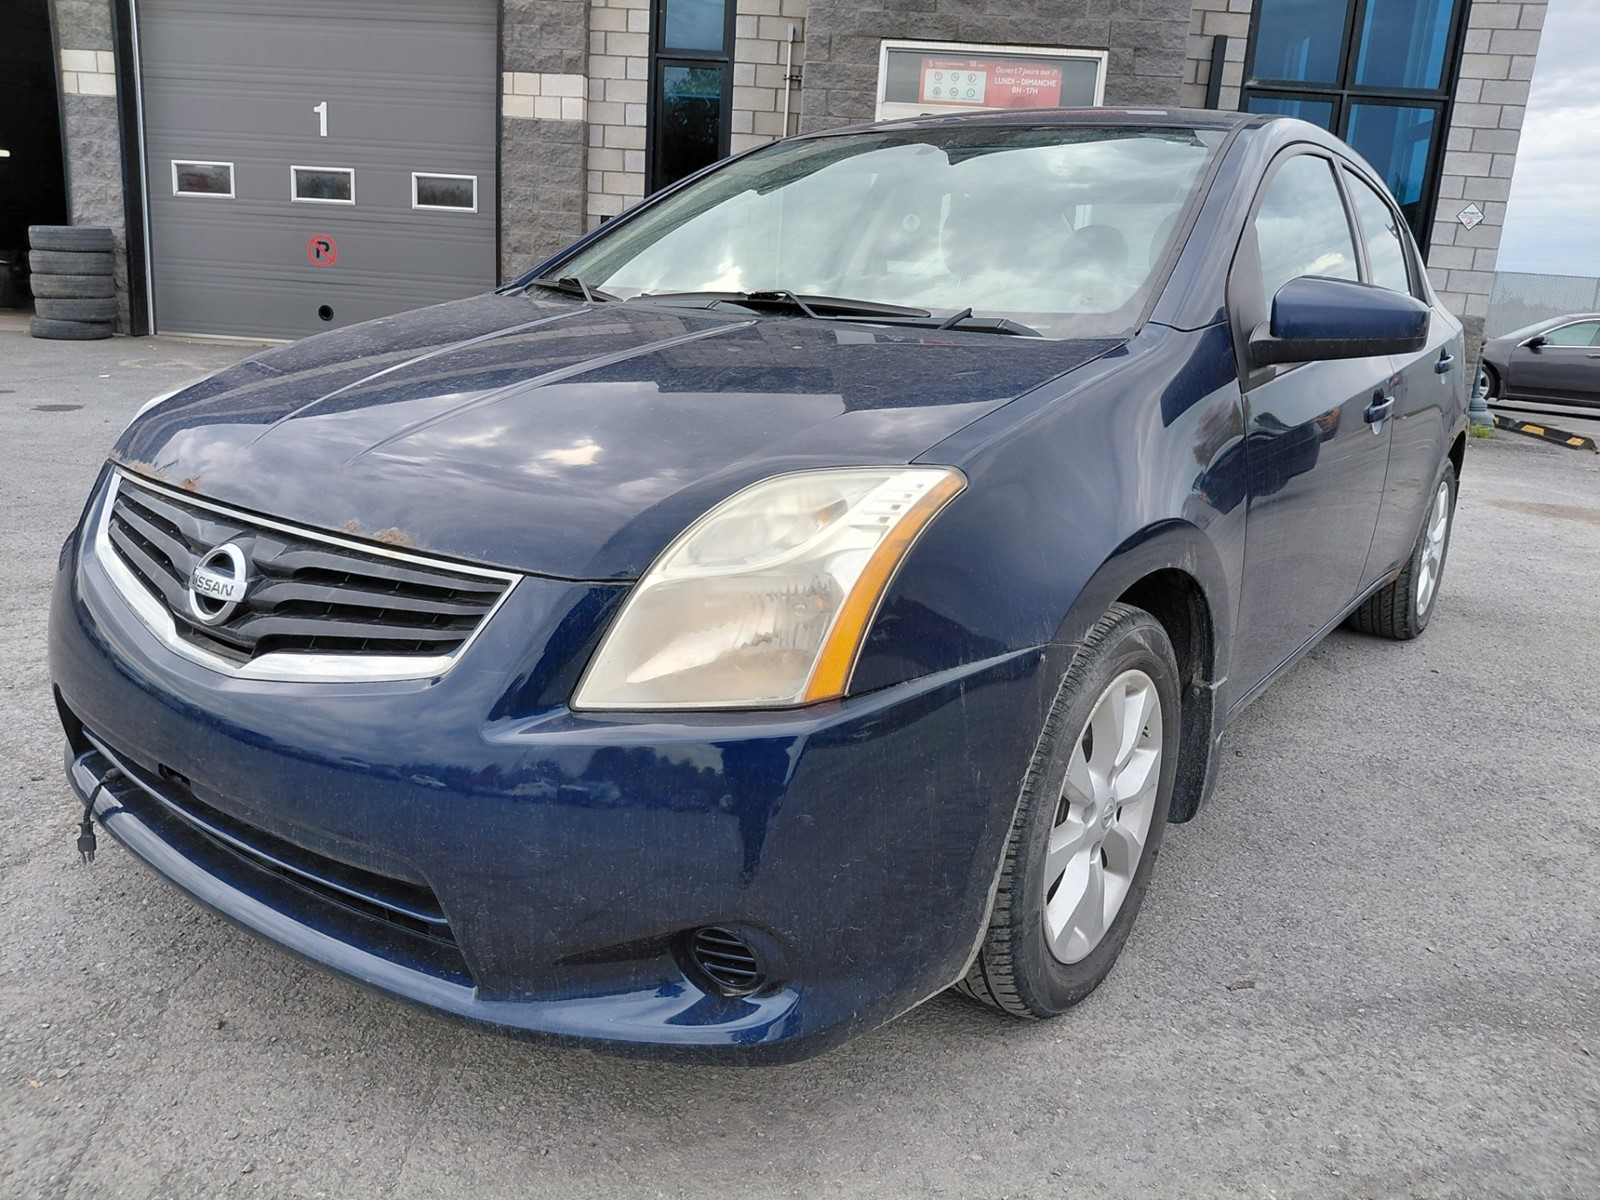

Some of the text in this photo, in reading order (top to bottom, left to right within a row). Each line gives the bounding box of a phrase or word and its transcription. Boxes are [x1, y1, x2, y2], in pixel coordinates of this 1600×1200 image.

[995, 66, 1018, 74] Ouvert
[1022, 68, 1039, 76] jours
[994, 77, 1015, 85] LUNDI
[1021, 78, 1058, 87] DIMANCHE
[1026, 87, 1039, 95] 17H
[313, 101, 328, 137] 1
